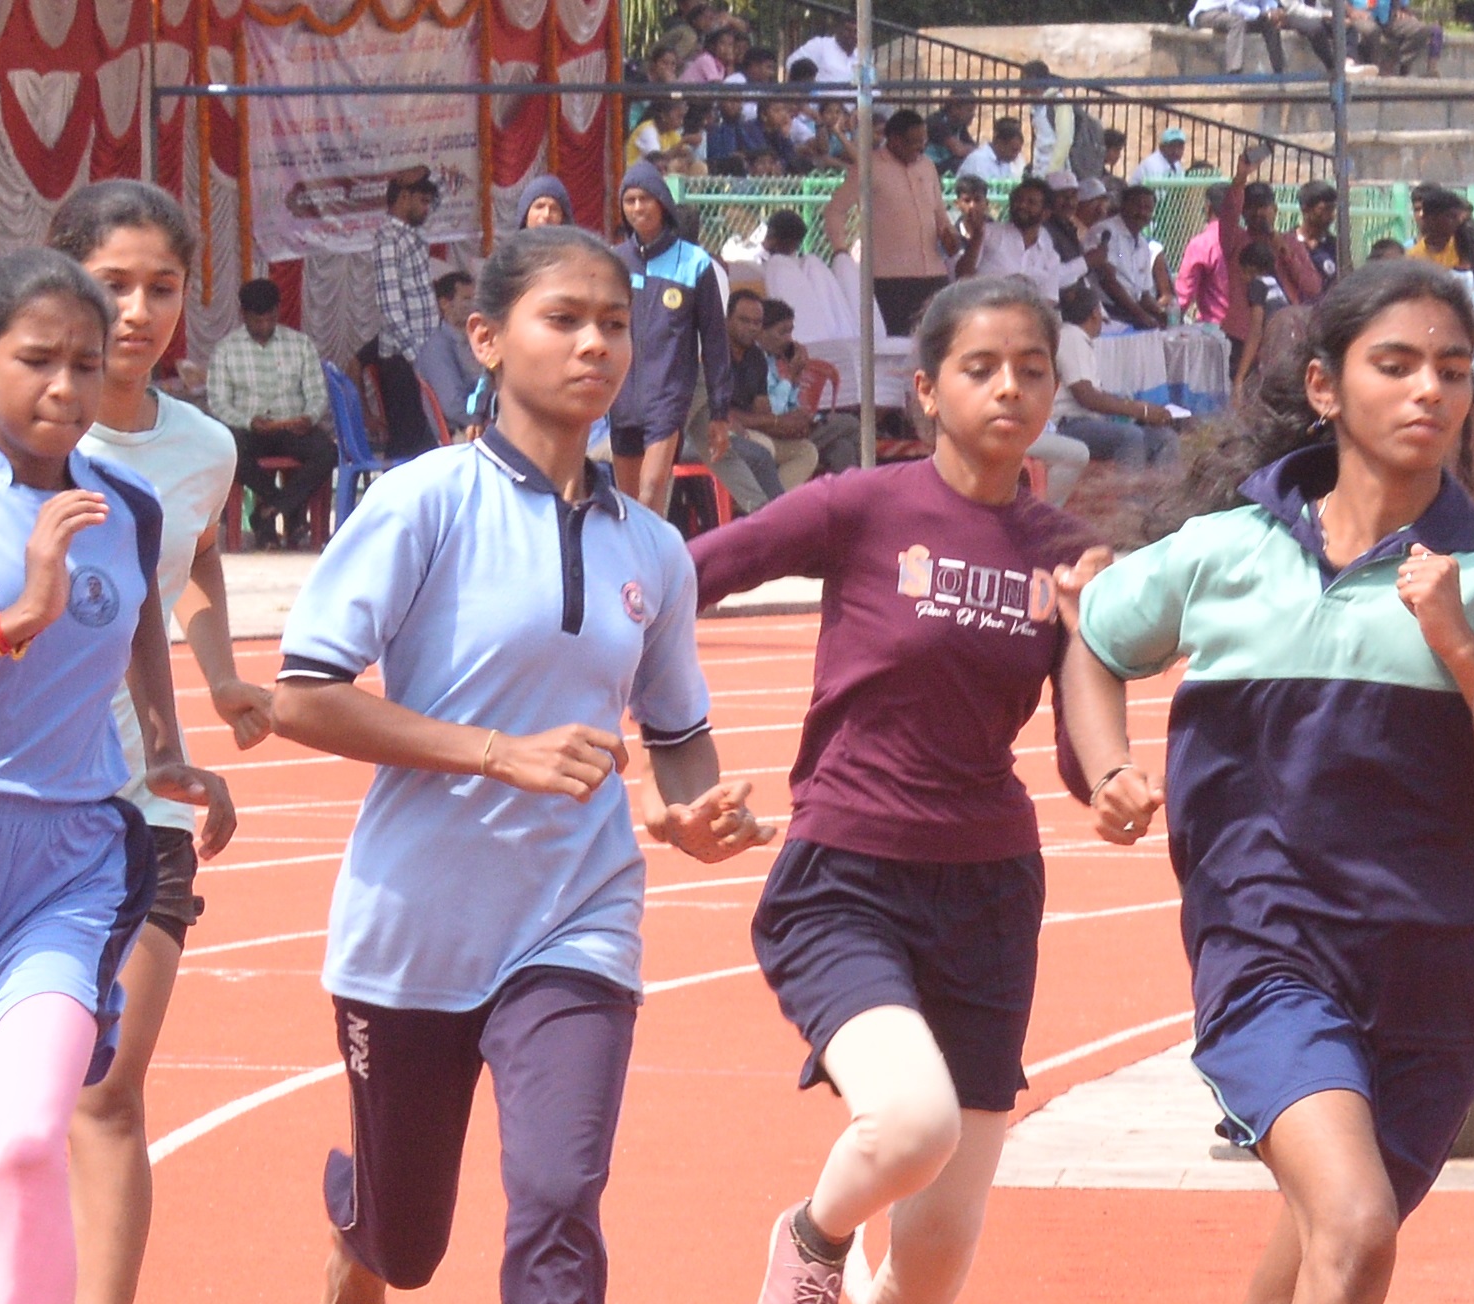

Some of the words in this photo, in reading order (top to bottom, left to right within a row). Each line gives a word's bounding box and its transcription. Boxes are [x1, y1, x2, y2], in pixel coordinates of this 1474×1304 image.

[898, 544, 1057, 623] SOUND
[956, 607, 977, 627] Of
[347, 1011, 369, 1080] RUN
